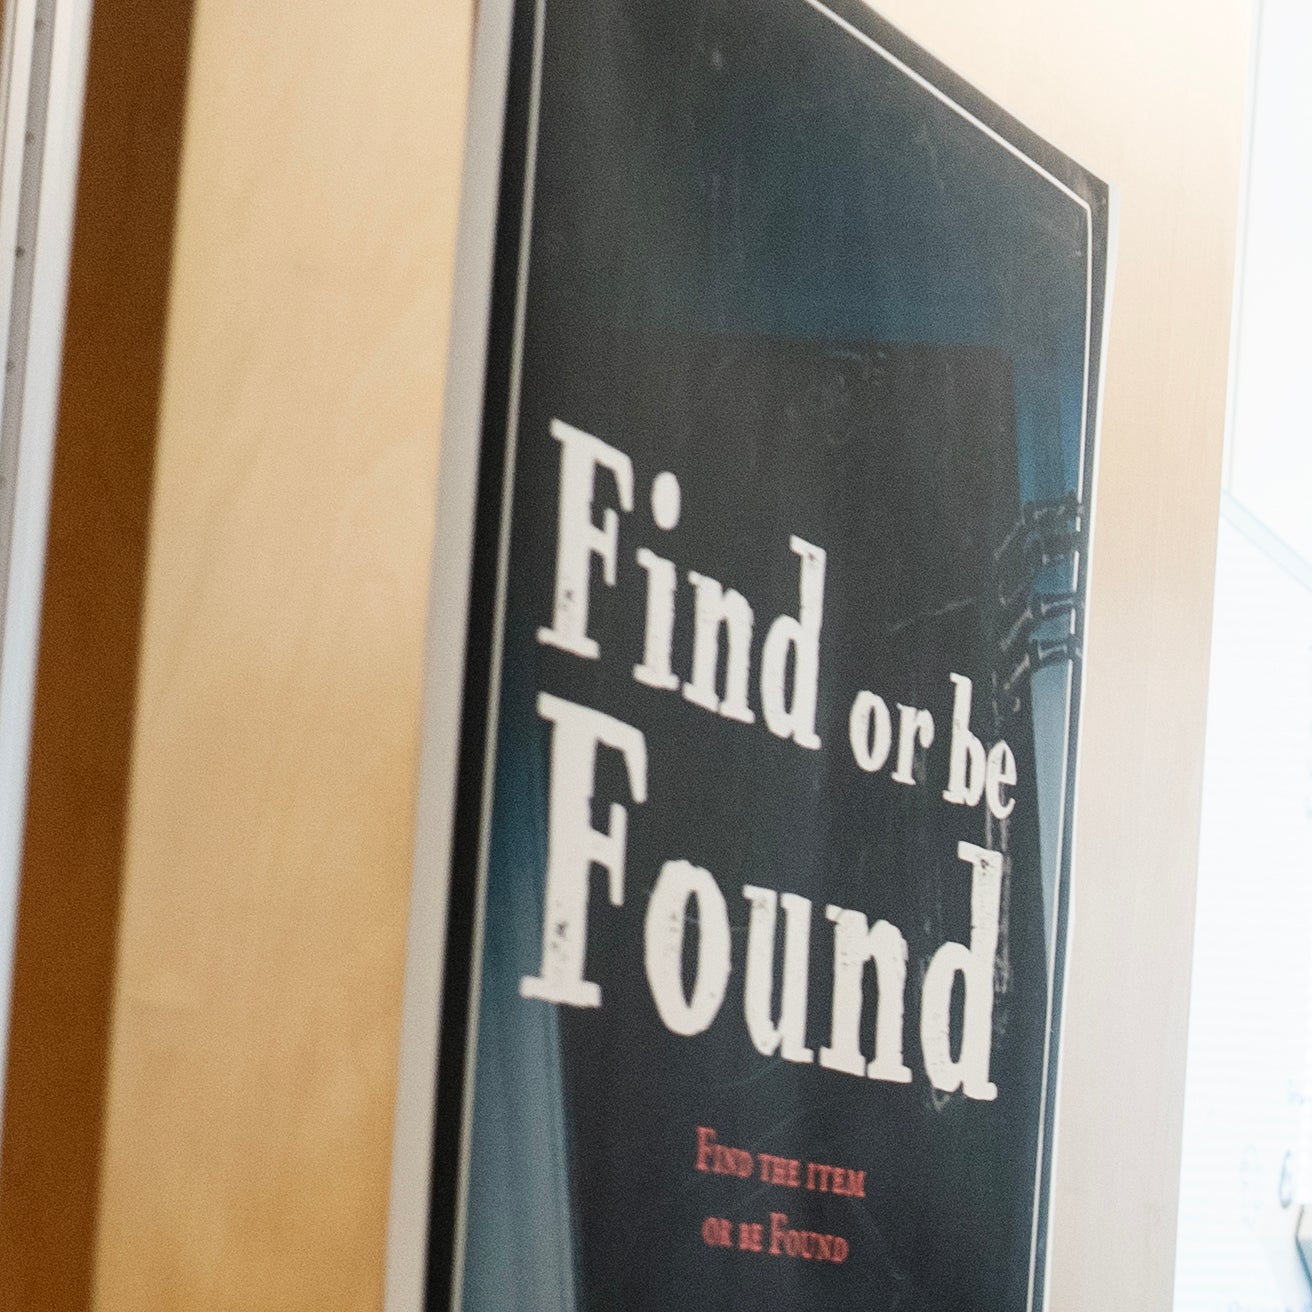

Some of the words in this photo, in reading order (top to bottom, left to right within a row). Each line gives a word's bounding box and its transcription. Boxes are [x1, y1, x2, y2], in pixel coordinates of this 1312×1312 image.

[536, 418, 827, 750] Find
[848, 690, 935, 785] or
[941, 672, 1018, 819] be
[519, 691, 1004, 1101] Found
